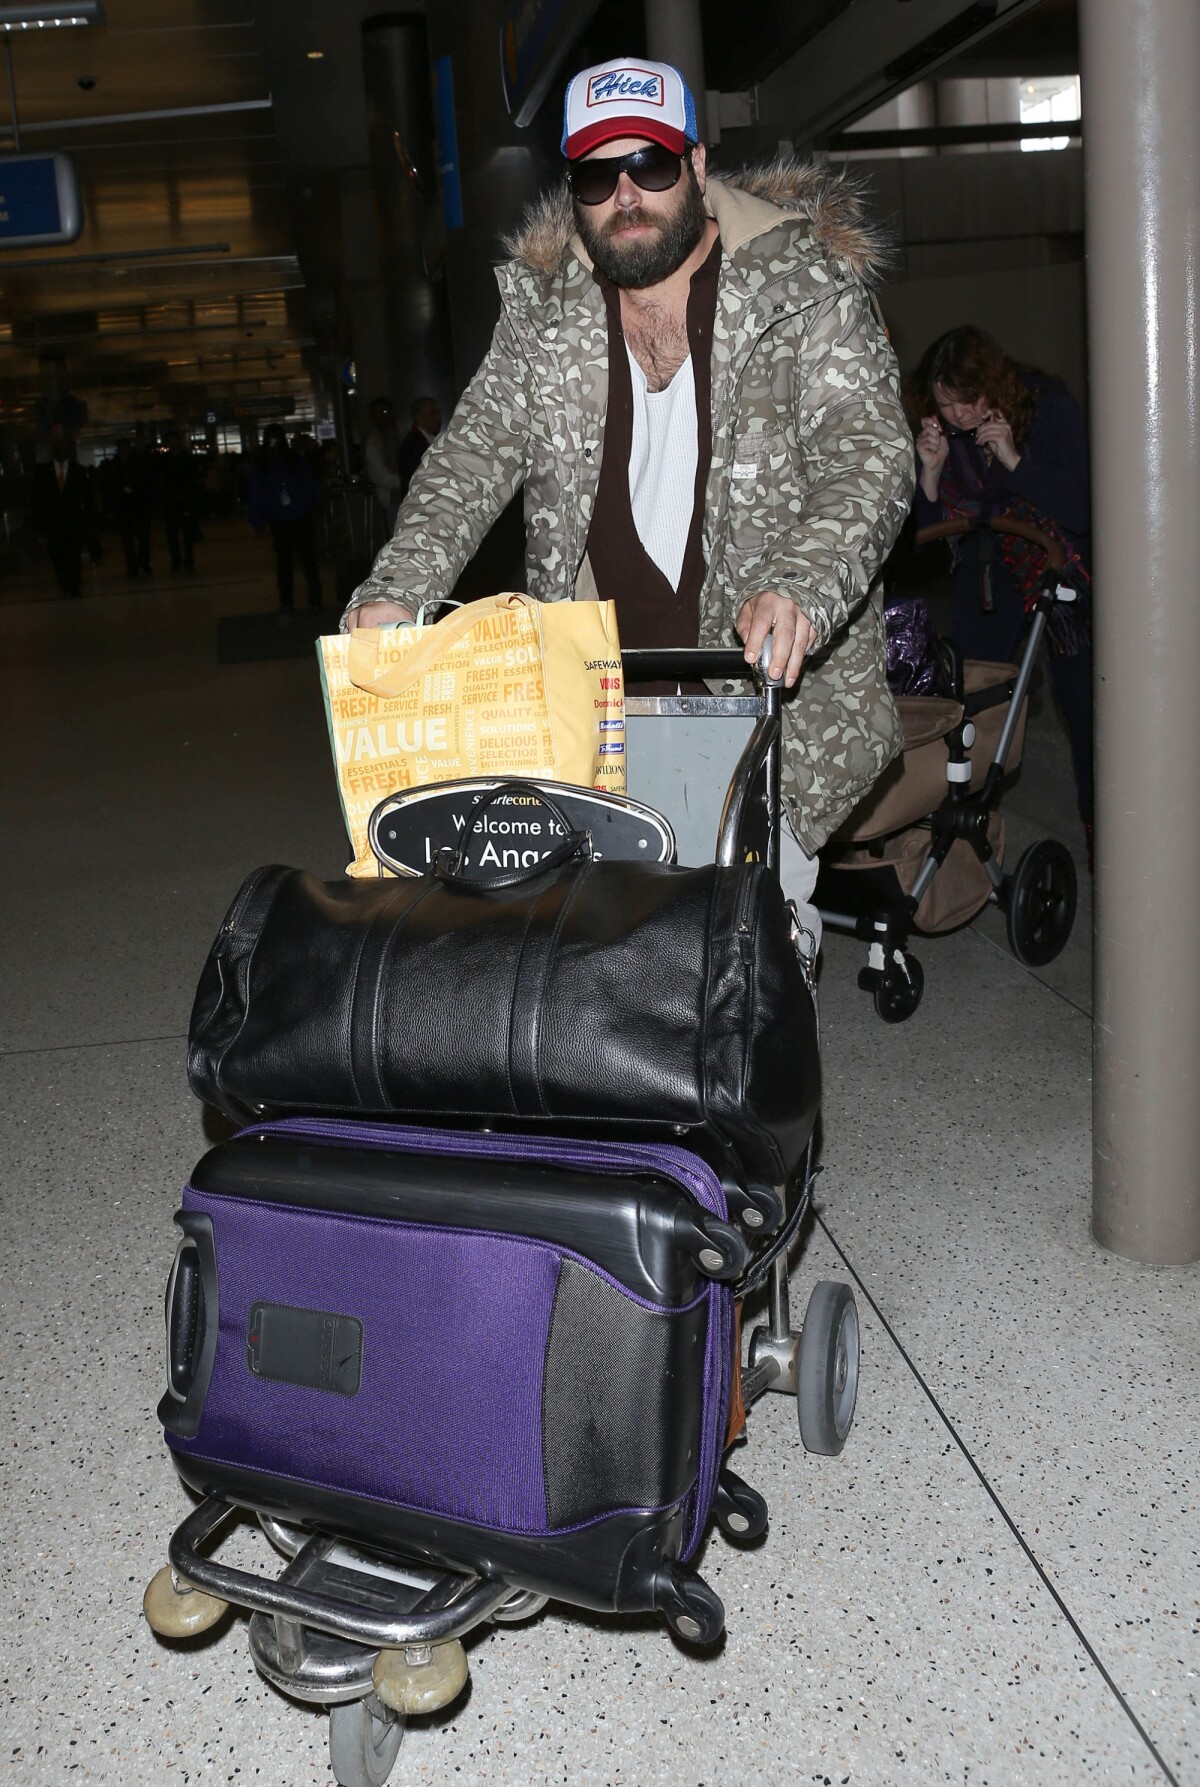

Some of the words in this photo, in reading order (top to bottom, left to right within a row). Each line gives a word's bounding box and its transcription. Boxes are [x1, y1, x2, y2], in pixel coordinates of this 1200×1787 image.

[591, 72, 659, 100] Hick
[472, 612, 518, 643] VALUE
[473, 639, 520, 654] SELECTION
[474, 655, 503, 667] VALUE
[584, 660, 623, 671] SAFEWAY
[466, 667, 499, 682] FRESH
[463, 682, 499, 693] QUALITY
[462, 691, 498, 705] SERVICE
[384, 699, 418, 712] SERVICE
[422, 703, 452, 717] FRESH
[372, 712, 418, 722] GUARANTEED
[481, 707, 531, 720] QUALITY
[480, 722, 537, 735] SOLUTIONS
[333, 717, 449, 764] VALUE
[480, 735, 537, 749] DELICIOUS
[480, 748, 537, 760] SELECTION
[347, 758, 408, 777] ESSENTIALS
[431, 757, 461, 769] VALUE
[480, 758, 538, 769] ENTERTAINING
[348, 769, 412, 795] FRESH
[452, 814, 542, 835] Welcome
